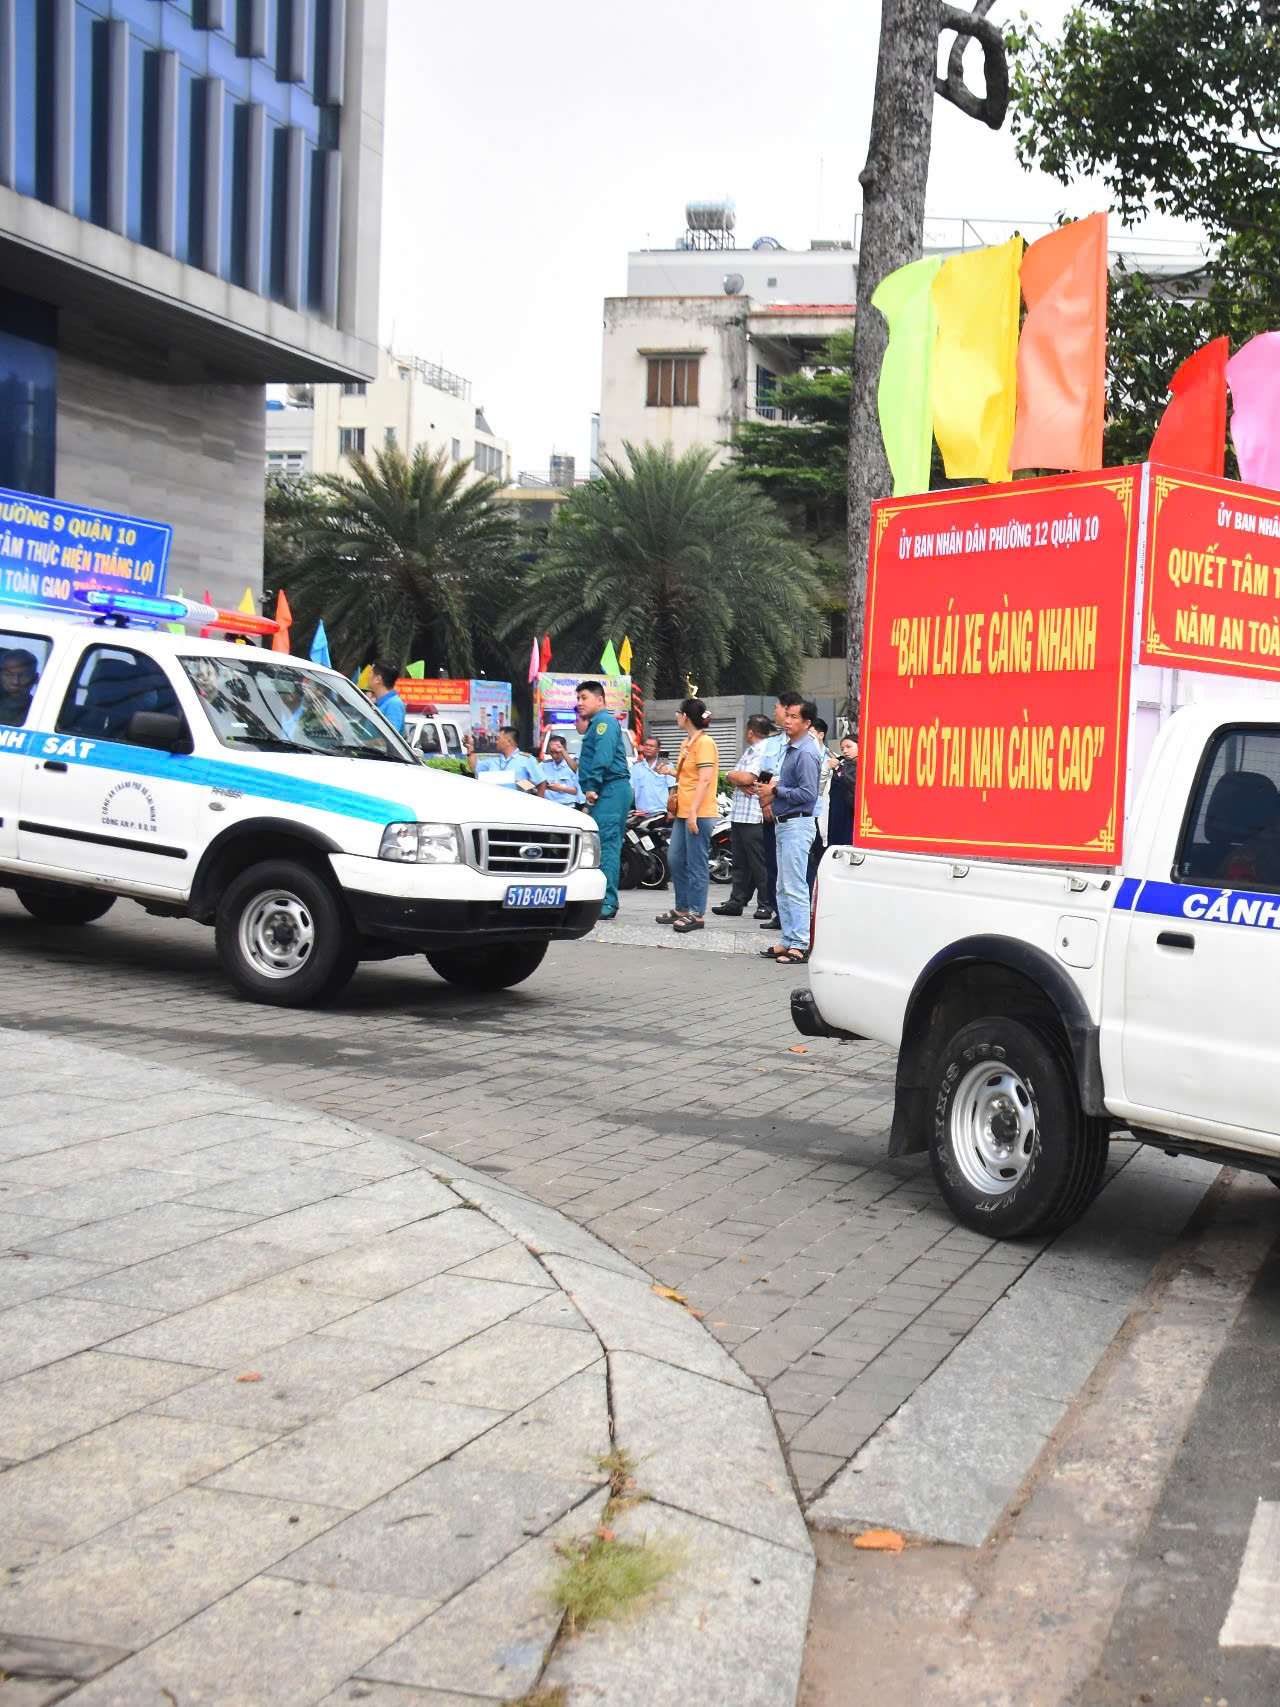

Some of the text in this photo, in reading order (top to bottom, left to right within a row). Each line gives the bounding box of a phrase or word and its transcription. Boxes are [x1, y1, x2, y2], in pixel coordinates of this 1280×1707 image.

[53, 514, 65, 532] 9
[68, 517, 113, 542] QUẬN
[117, 527, 137, 547] 10
[899, 512, 1099, 560] ỦY BAN NHÂN DÂN PHƯỜNG 12 QUẬN 10
[1217, 502, 1233, 528] ỦY
[1234, 511, 1257, 533] BAN
[5, 567, 40, 596] TOÀN
[41, 576, 71, 601] GIAO
[26, 539, 61, 568] THỰC
[60, 544, 92, 574] HIỆN
[93, 547, 134, 579] THẮNG
[133, 559, 155, 586] LỢI
[1168, 543, 1228, 589] QUYẾT
[1232, 553, 1269, 597] TÂM
[932, 597, 960, 675] LÁI
[961, 613, 985, 675] XE
[987, 594, 1034, 675] CÀNG
[1036, 605, 1098, 672] NHANH
[1175, 604, 1215, 647] NĂM
[1220, 615, 1245, 651] AN
[42, 736, 96, 759] SÁT
[874, 726, 914, 786] NGUY
[916, 717, 939, 787] CƠ
[941, 727, 967, 787] TAI
[969, 727, 1005, 802] NẠN
[1007, 708, 1054, 791] CÀNG
